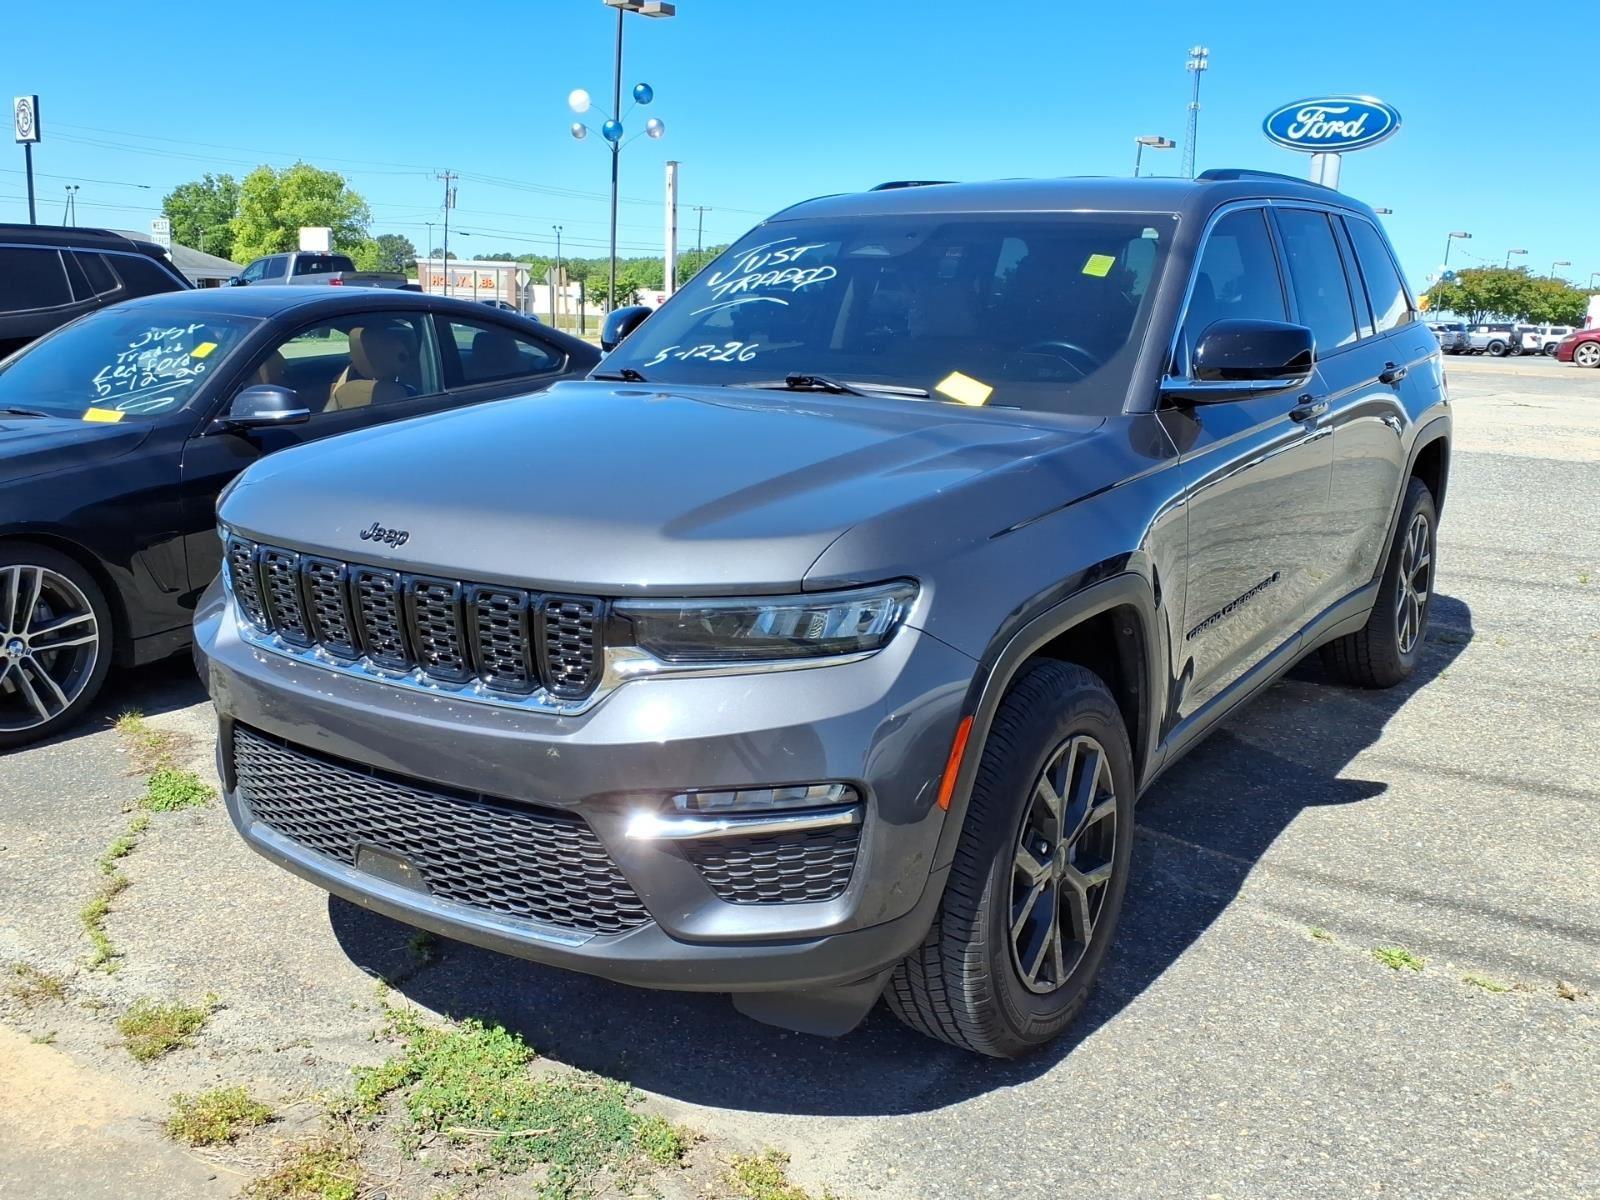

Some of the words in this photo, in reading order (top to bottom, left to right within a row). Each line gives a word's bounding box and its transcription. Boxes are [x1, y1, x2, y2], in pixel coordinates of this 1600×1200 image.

[1287, 106, 1370, 139] Ford
[707, 237, 829, 287] JUST
[712, 266, 837, 300] TRADED
[360, 522, 410, 549] Jeep
